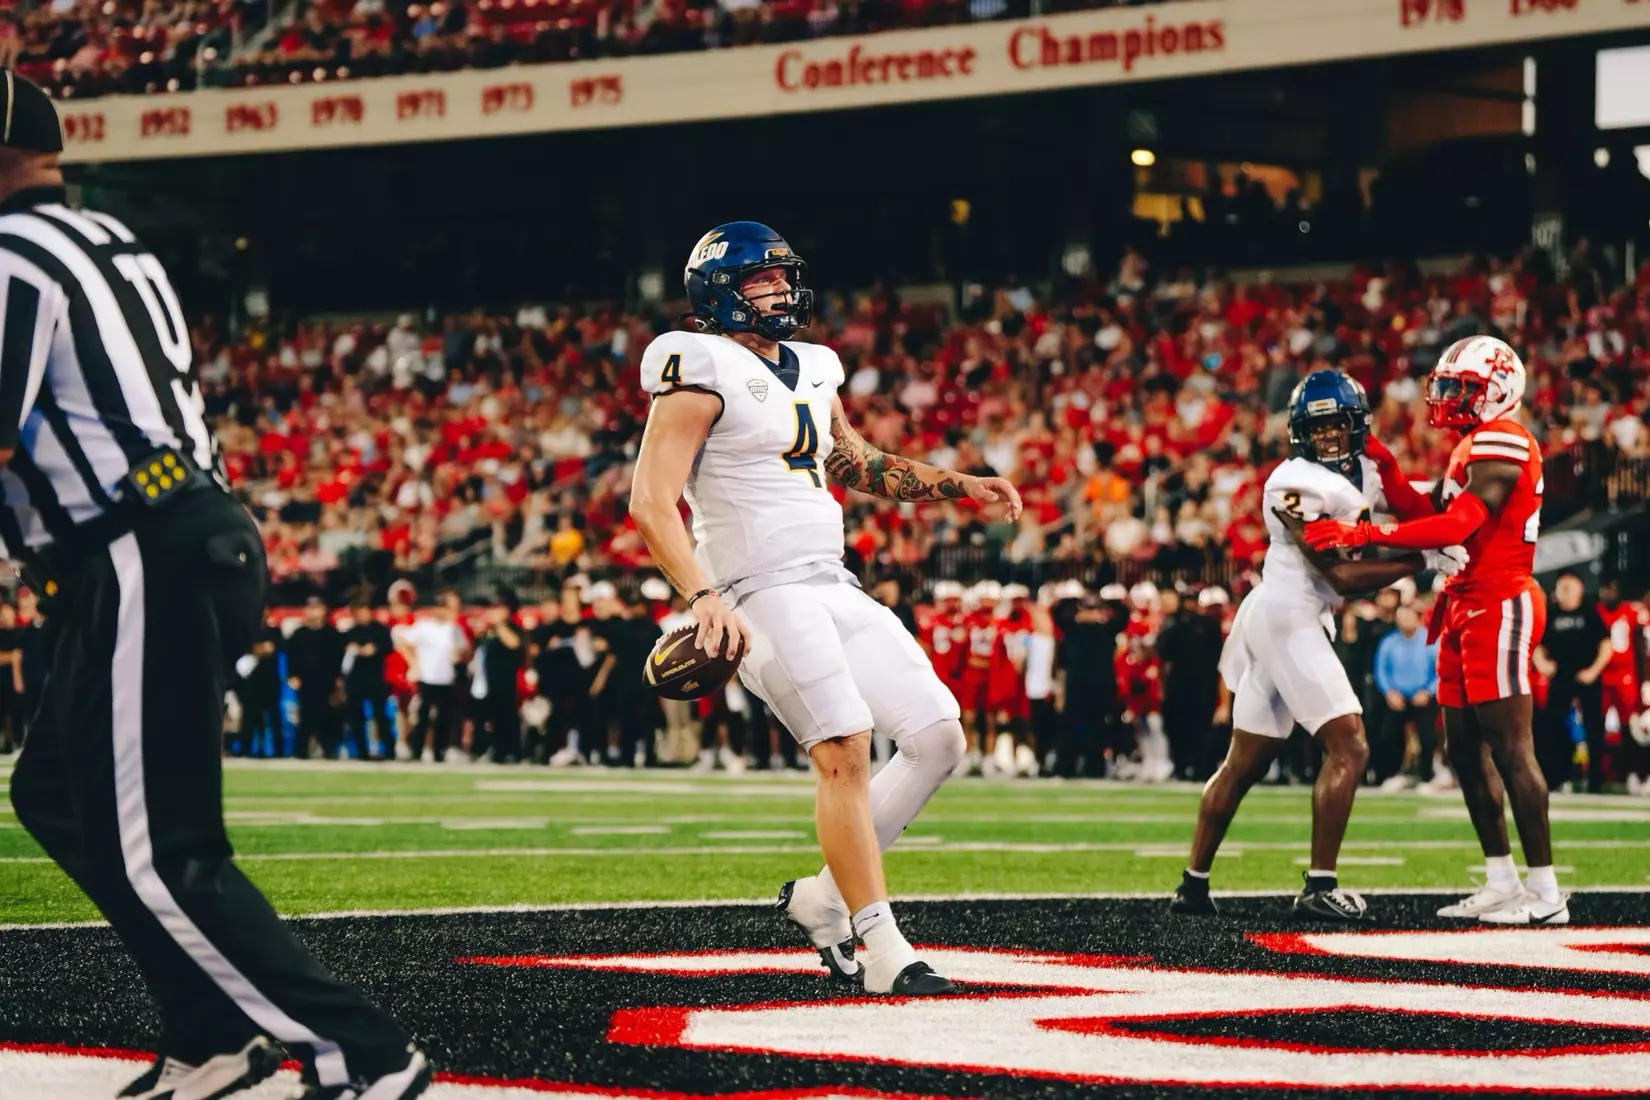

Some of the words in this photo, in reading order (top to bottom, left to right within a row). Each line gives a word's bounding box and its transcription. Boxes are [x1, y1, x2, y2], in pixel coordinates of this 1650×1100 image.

[774, 42, 977, 92] Conference
[1006, 15, 1226, 73] Champions
[63, 113, 105, 141] 932
[139, 107, 191, 137] 1952
[225, 101, 277, 131] 1963
[396, 88, 446, 119] 1971
[481, 82, 534, 114] 1973
[569, 74, 622, 107] 1975
[659, 352, 682, 387] 4
[779, 400, 822, 488] 4
[1280, 491, 1304, 517] 2
